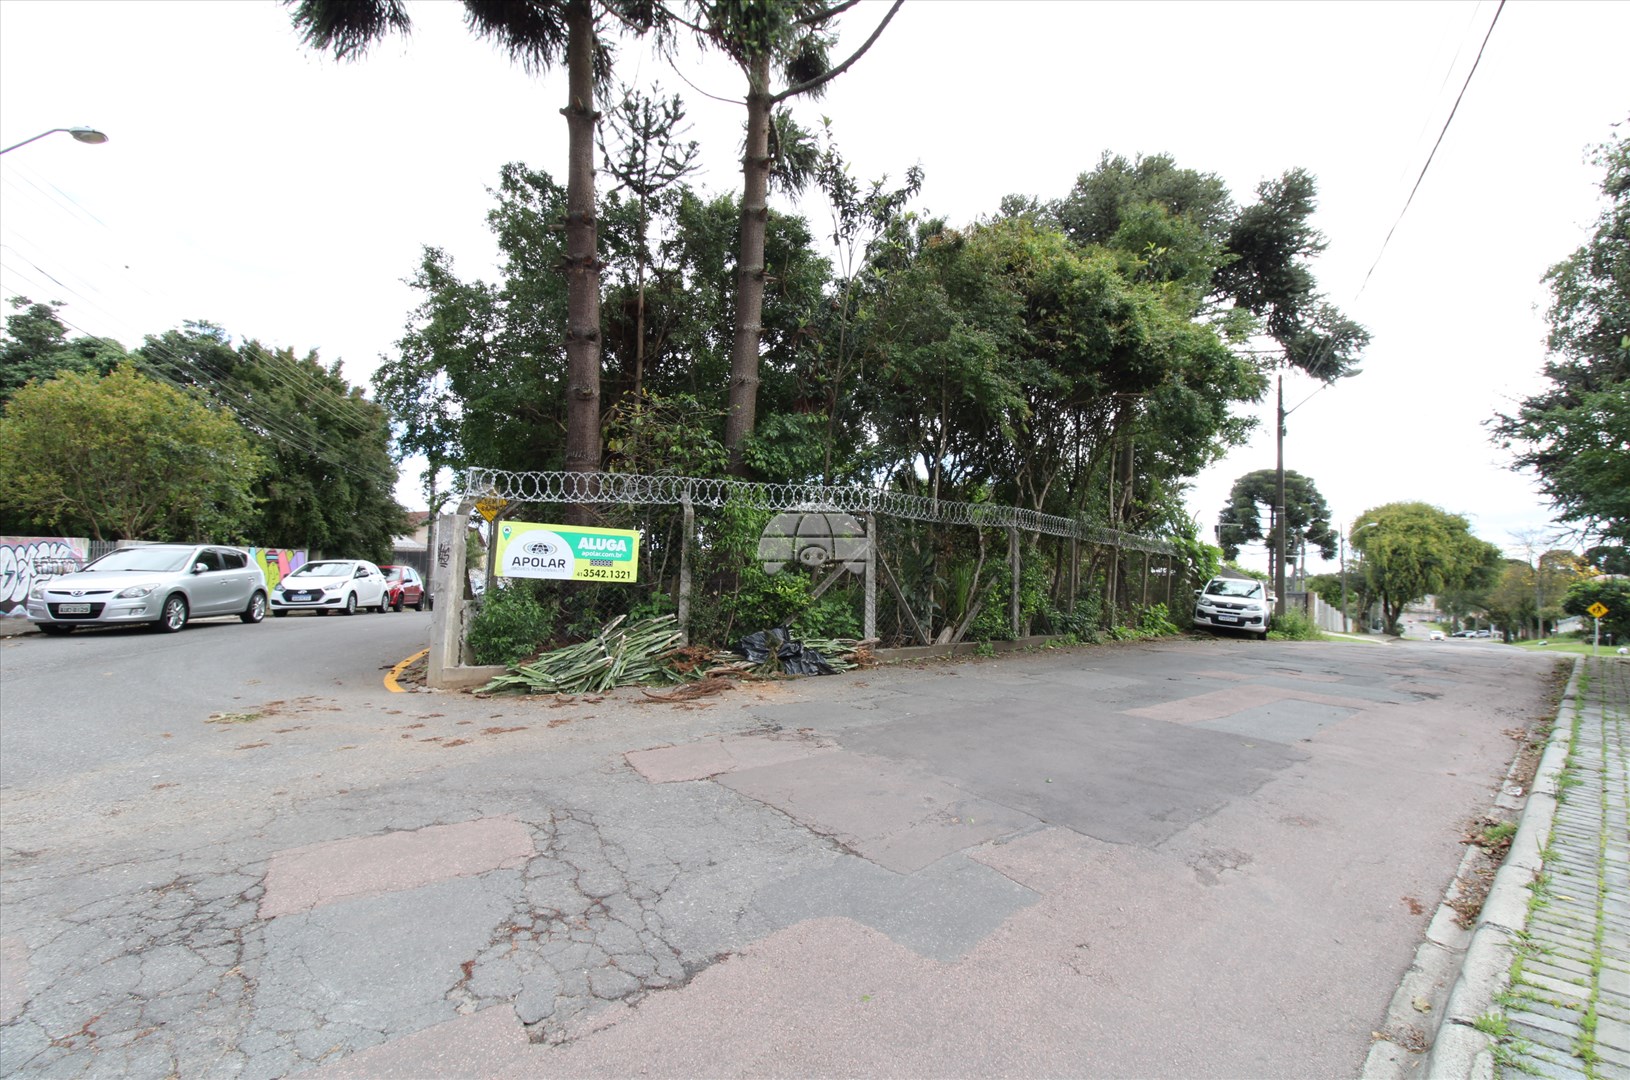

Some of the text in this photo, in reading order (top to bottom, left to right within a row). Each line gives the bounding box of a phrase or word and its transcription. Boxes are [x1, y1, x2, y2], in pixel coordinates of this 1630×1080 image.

[578, 537, 627, 552] ALUGA
[512, 556, 566, 569] APOLAR
[583, 569, 630, 579] 3542.1321
